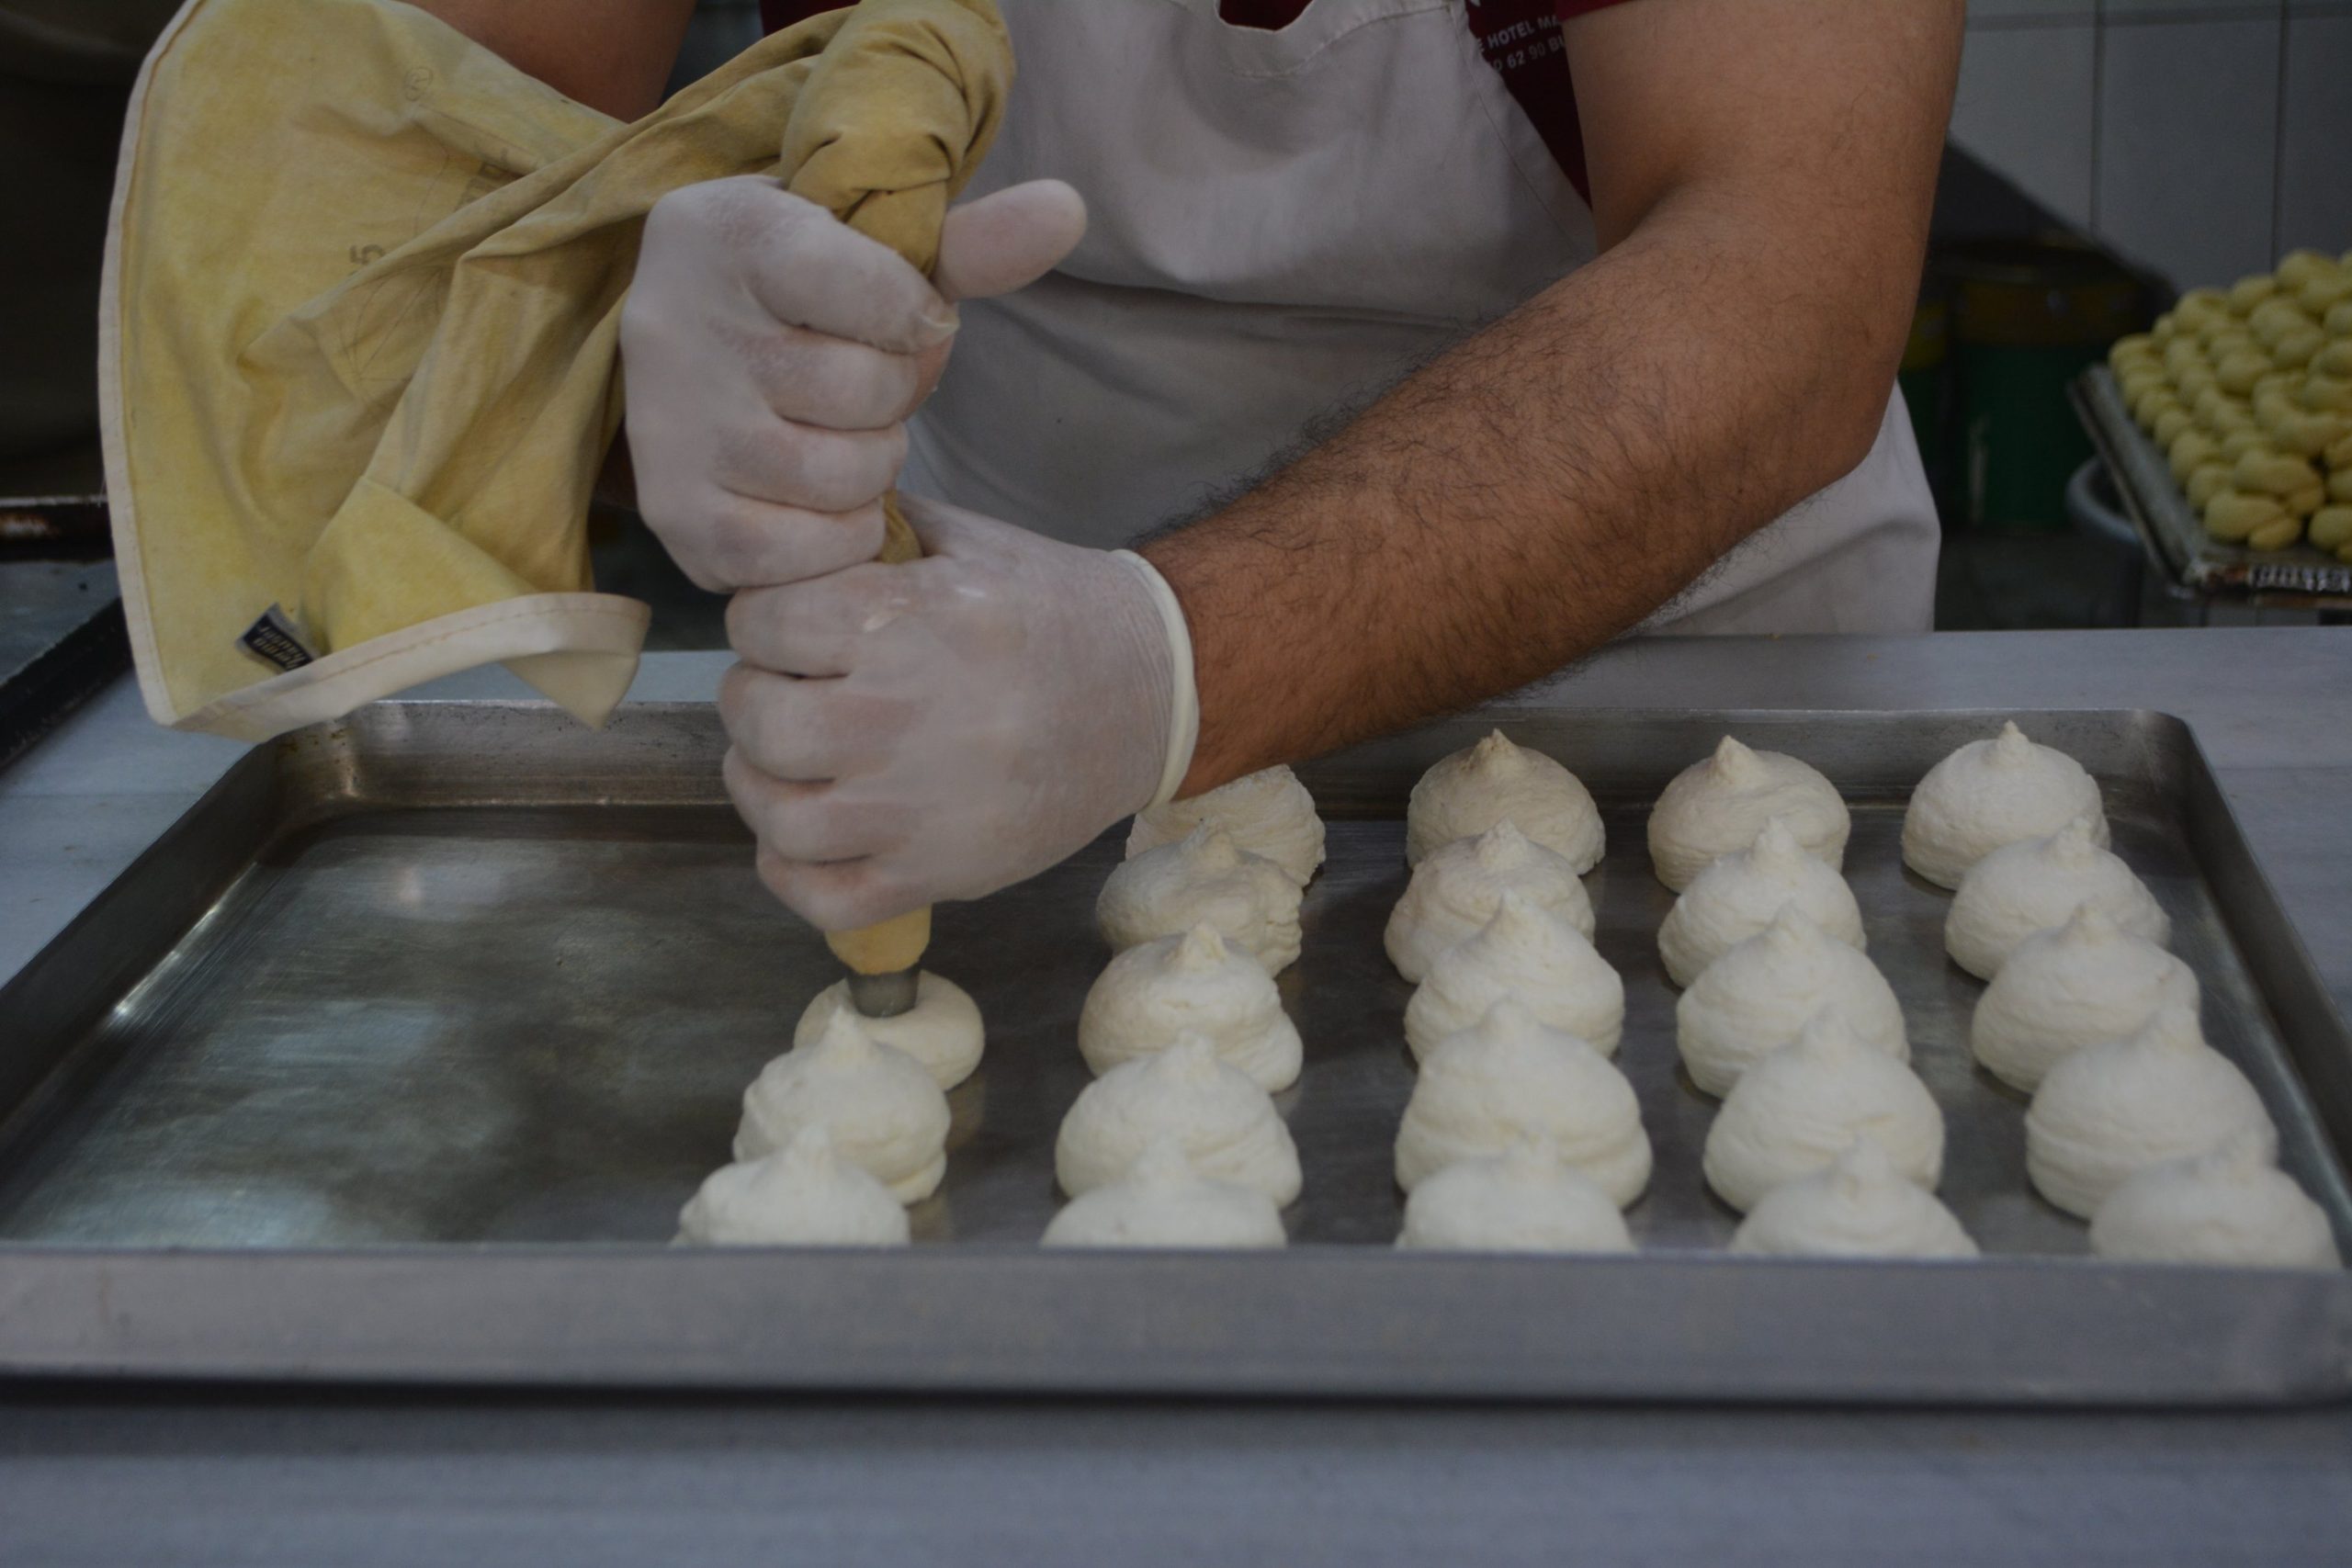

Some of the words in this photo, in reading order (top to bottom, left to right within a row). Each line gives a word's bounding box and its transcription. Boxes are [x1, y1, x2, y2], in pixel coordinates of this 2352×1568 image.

[1487, 20, 1535, 50] HOTEL
[1508, 49, 1525, 69] 62
[1529, 42, 1545, 60] 90
